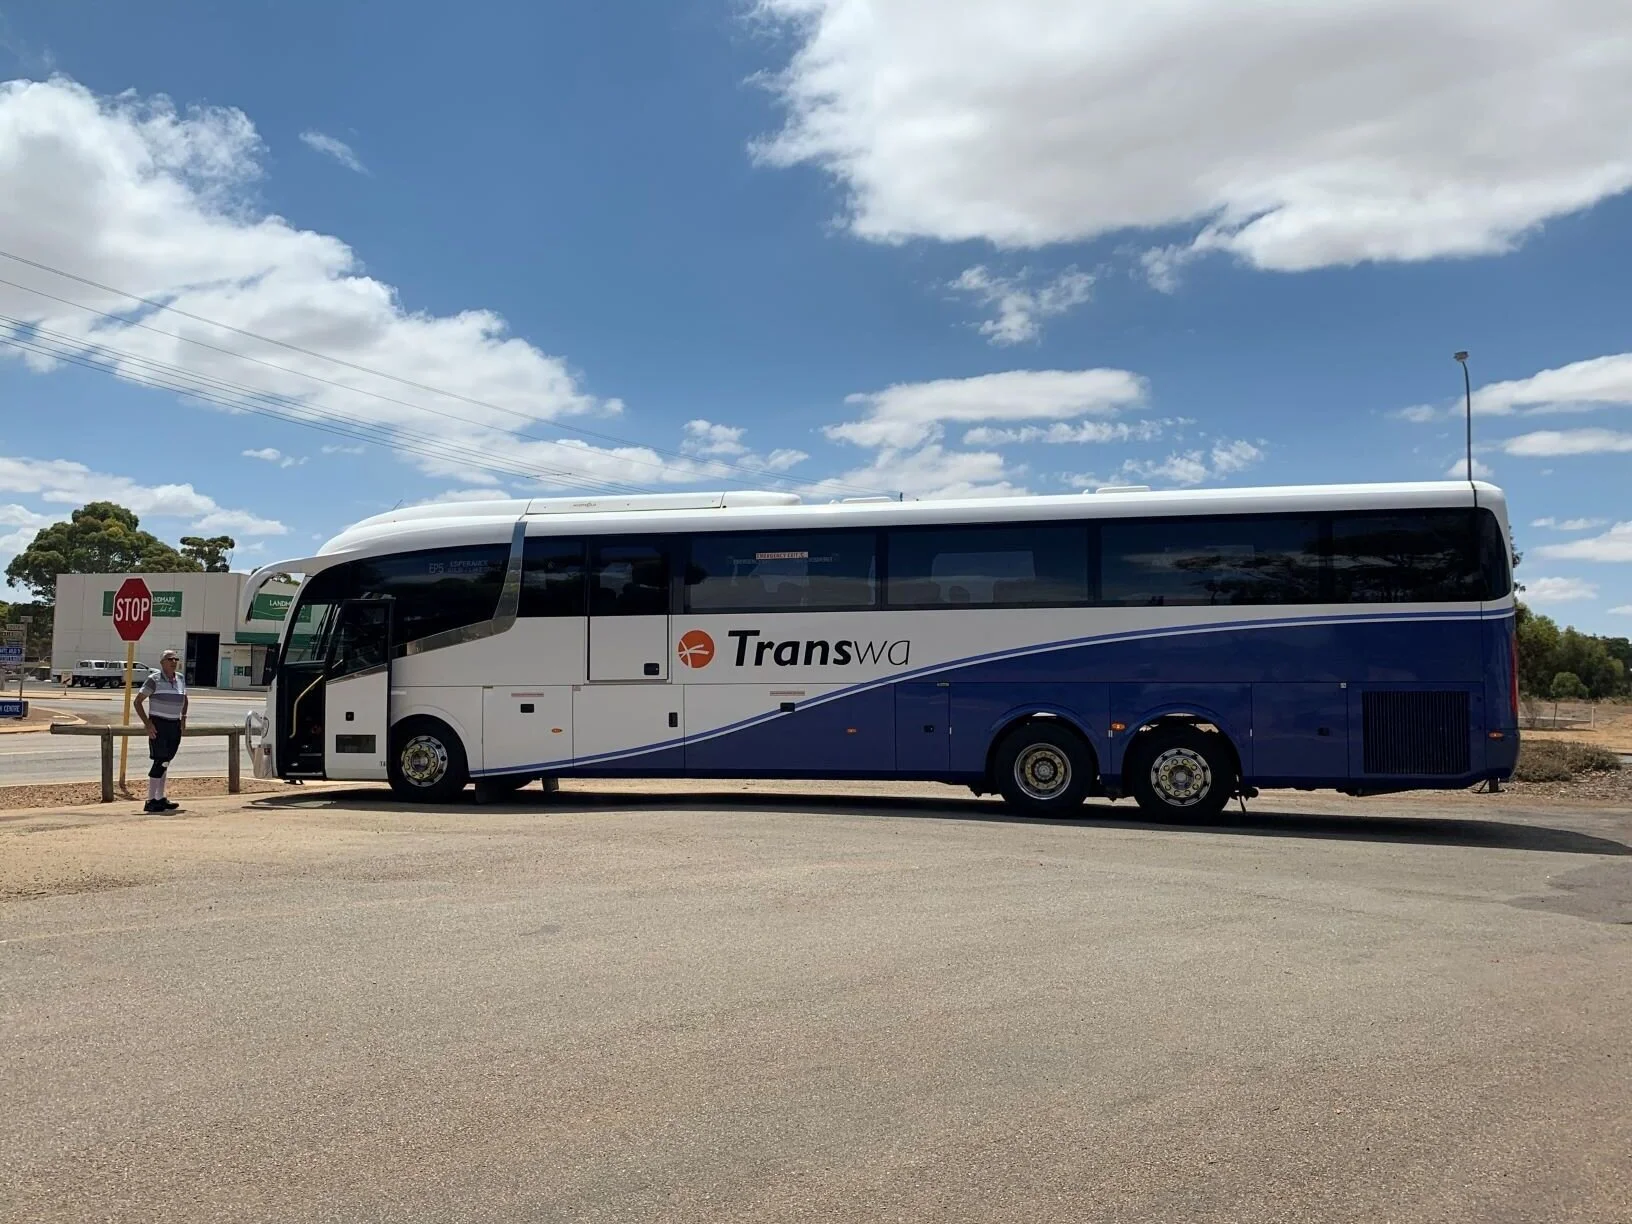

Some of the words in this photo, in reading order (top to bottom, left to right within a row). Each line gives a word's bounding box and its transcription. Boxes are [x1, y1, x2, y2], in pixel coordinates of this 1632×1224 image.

[115, 597, 150, 622] STOP
[152, 596, 176, 604] NDMARK
[728, 629, 911, 667] Transwa
